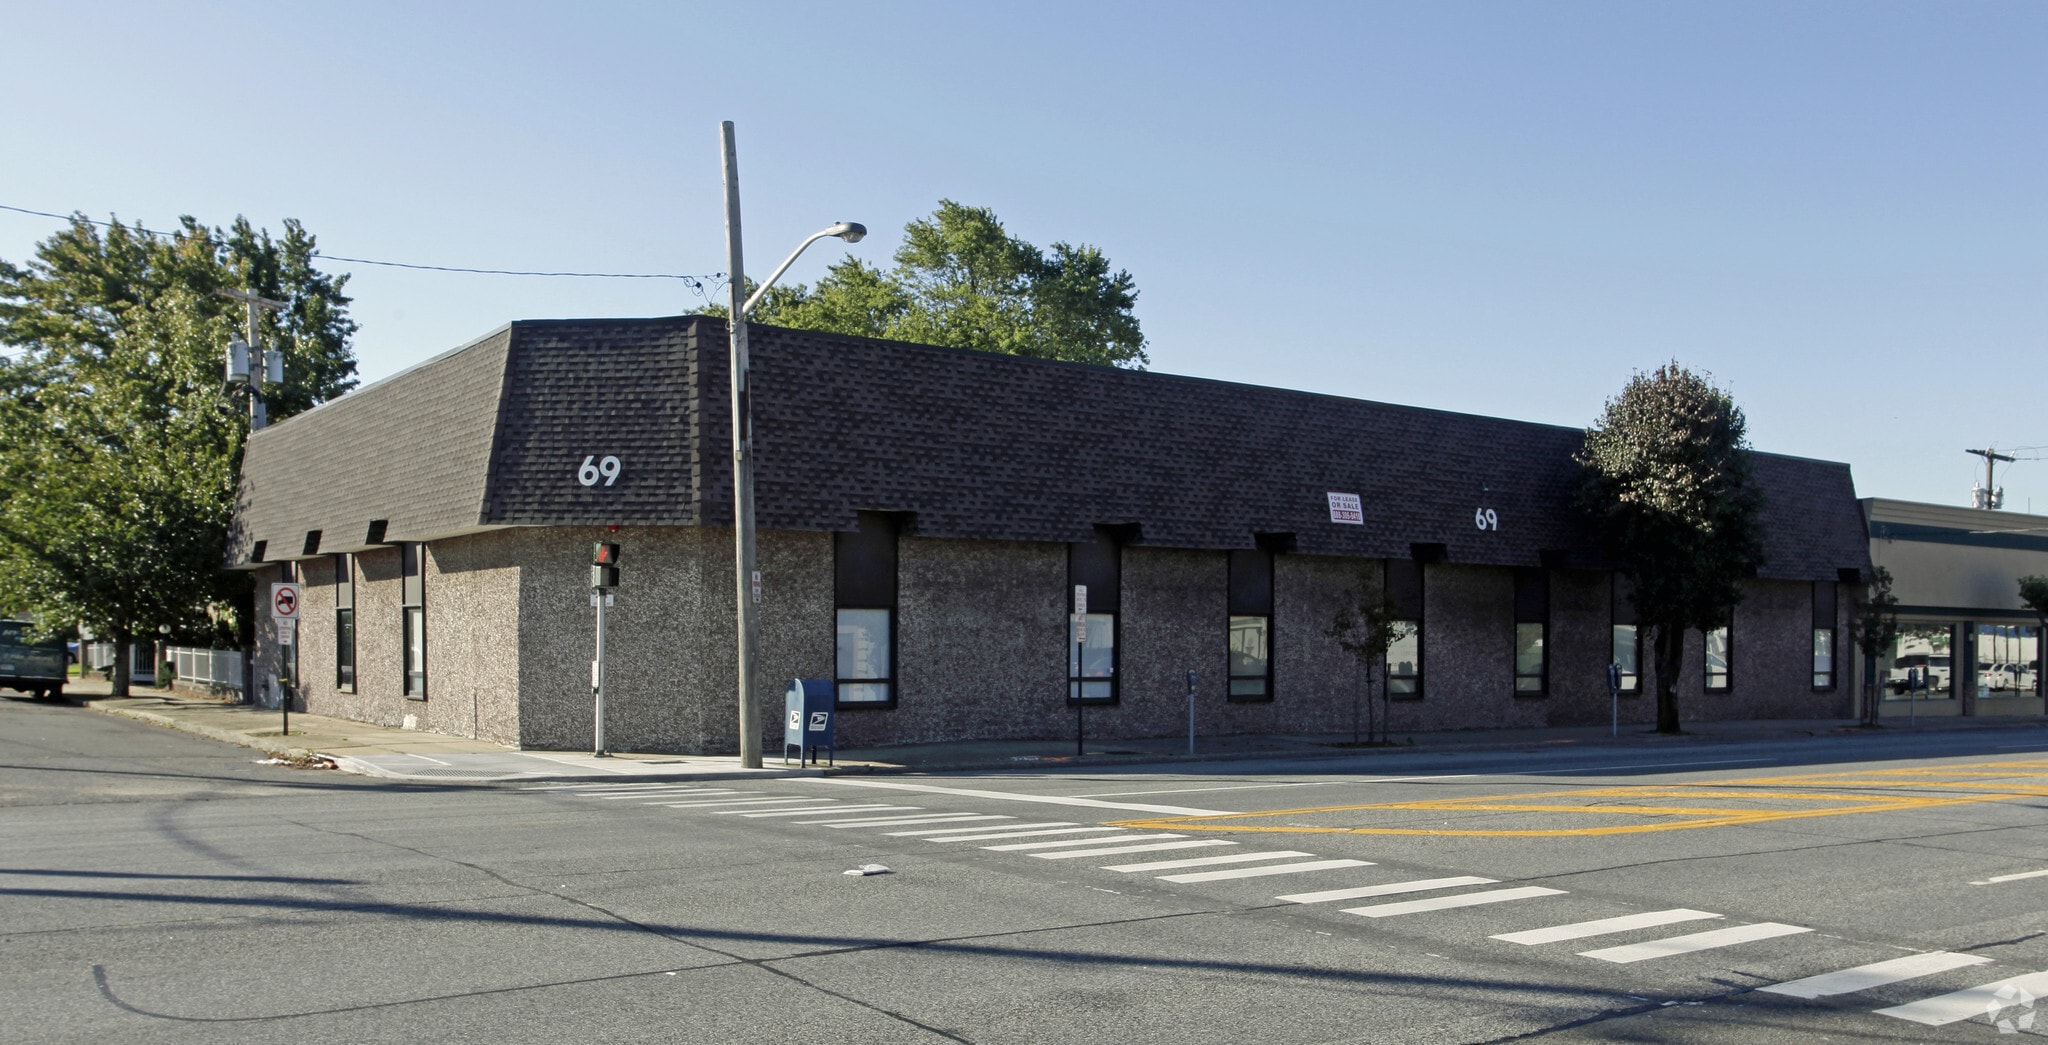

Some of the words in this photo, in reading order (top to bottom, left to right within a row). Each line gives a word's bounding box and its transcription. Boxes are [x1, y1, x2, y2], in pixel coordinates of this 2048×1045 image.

[578, 455, 621, 487] 69
[1331, 501, 1341, 509] OR
[1343, 502, 1359, 510] SALE
[1475, 507, 1498, 531] 69
